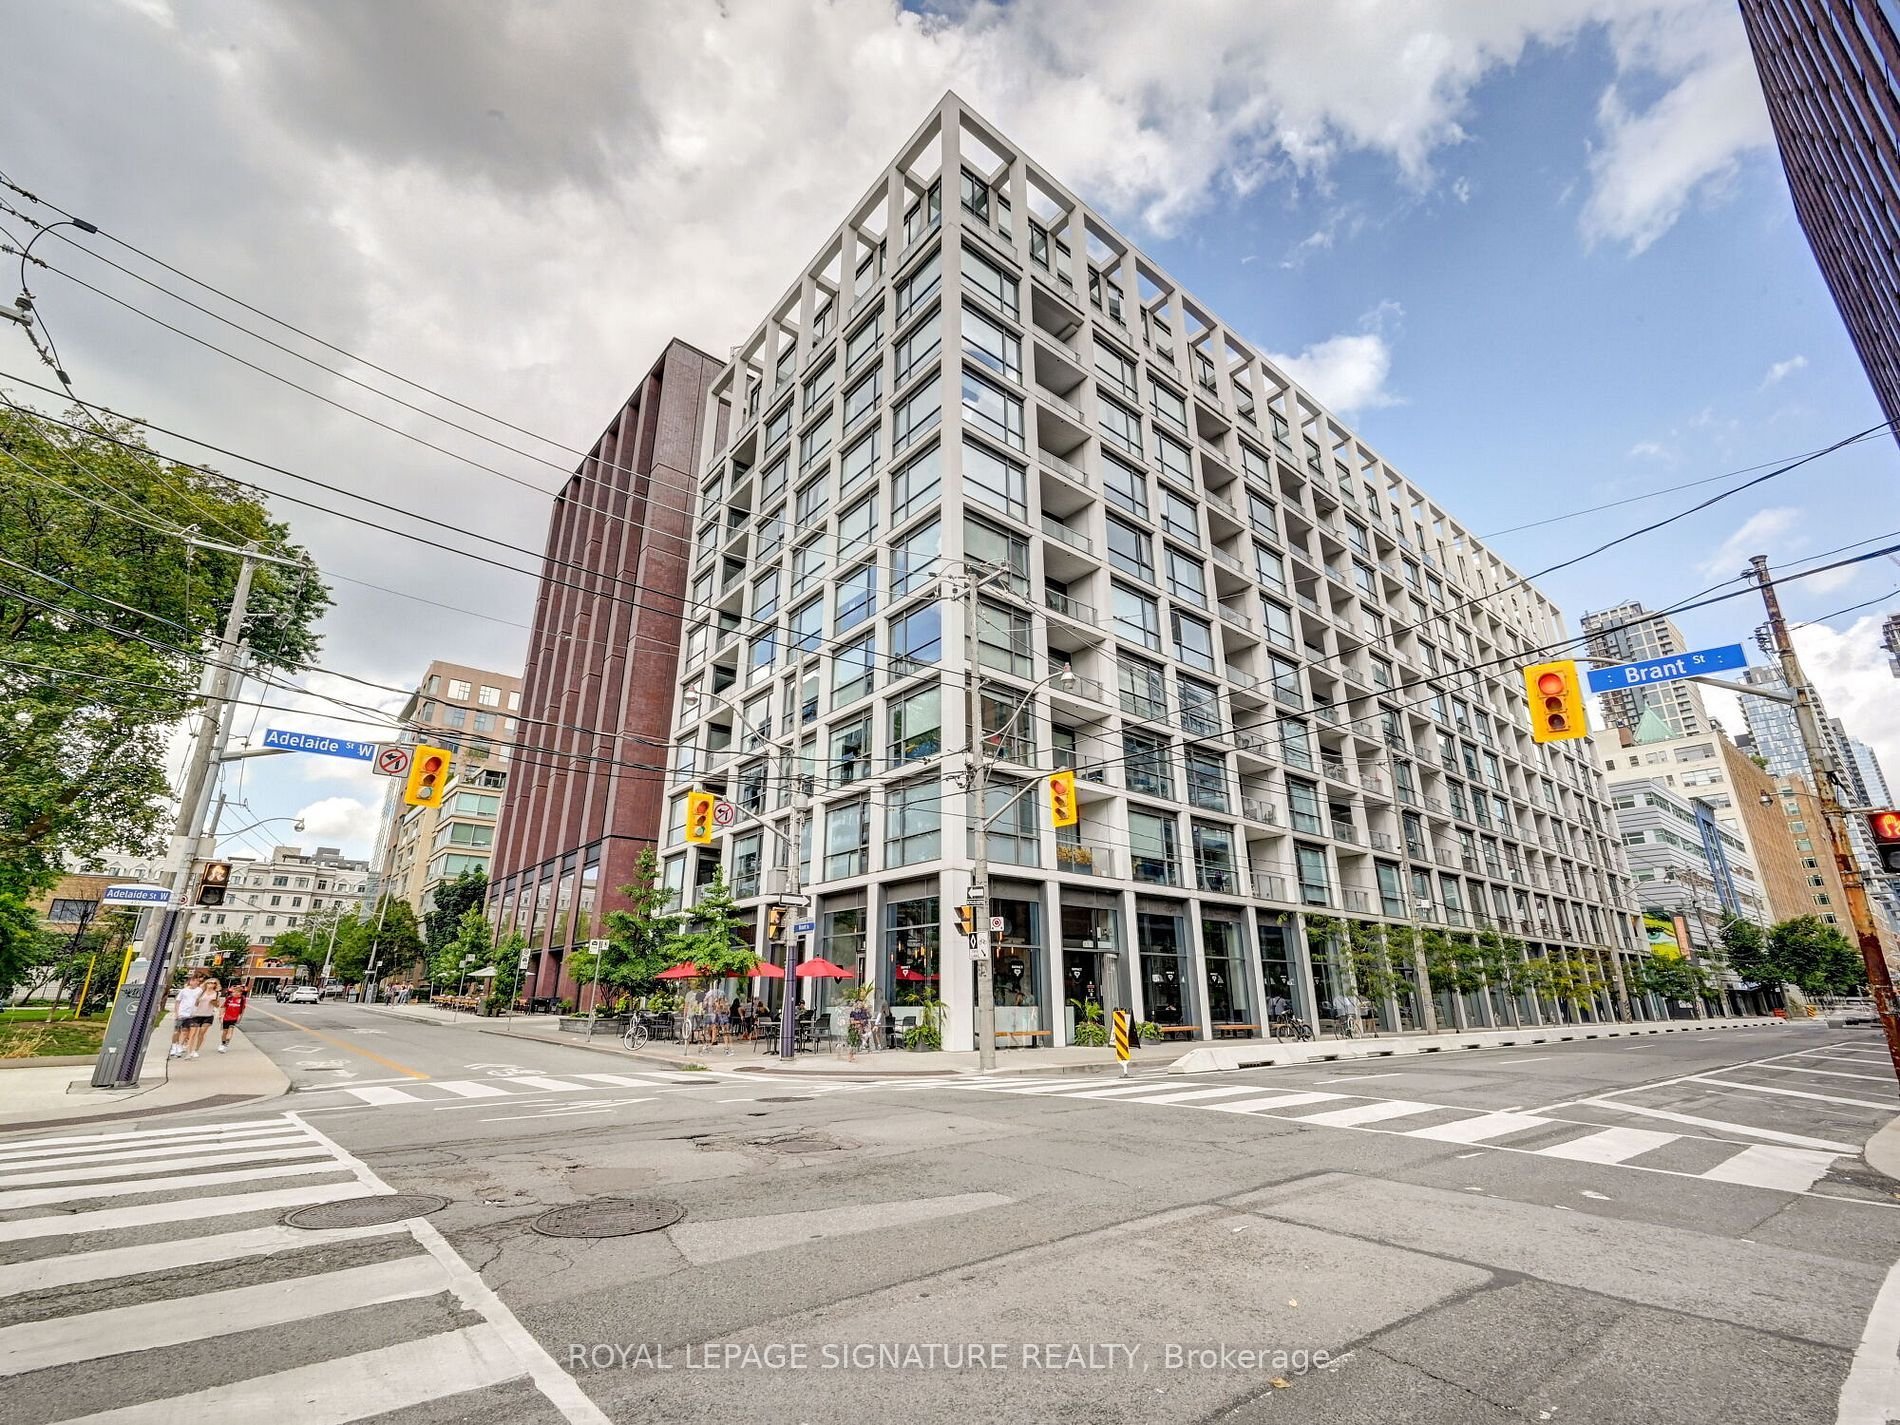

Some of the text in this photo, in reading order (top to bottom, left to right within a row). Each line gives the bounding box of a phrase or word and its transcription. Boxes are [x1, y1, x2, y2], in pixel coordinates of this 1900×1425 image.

[1624, 653, 1706, 683] Brant St
[267, 731, 373, 757] Adelaide St W
[106, 889, 169, 900] Adelaide St W
